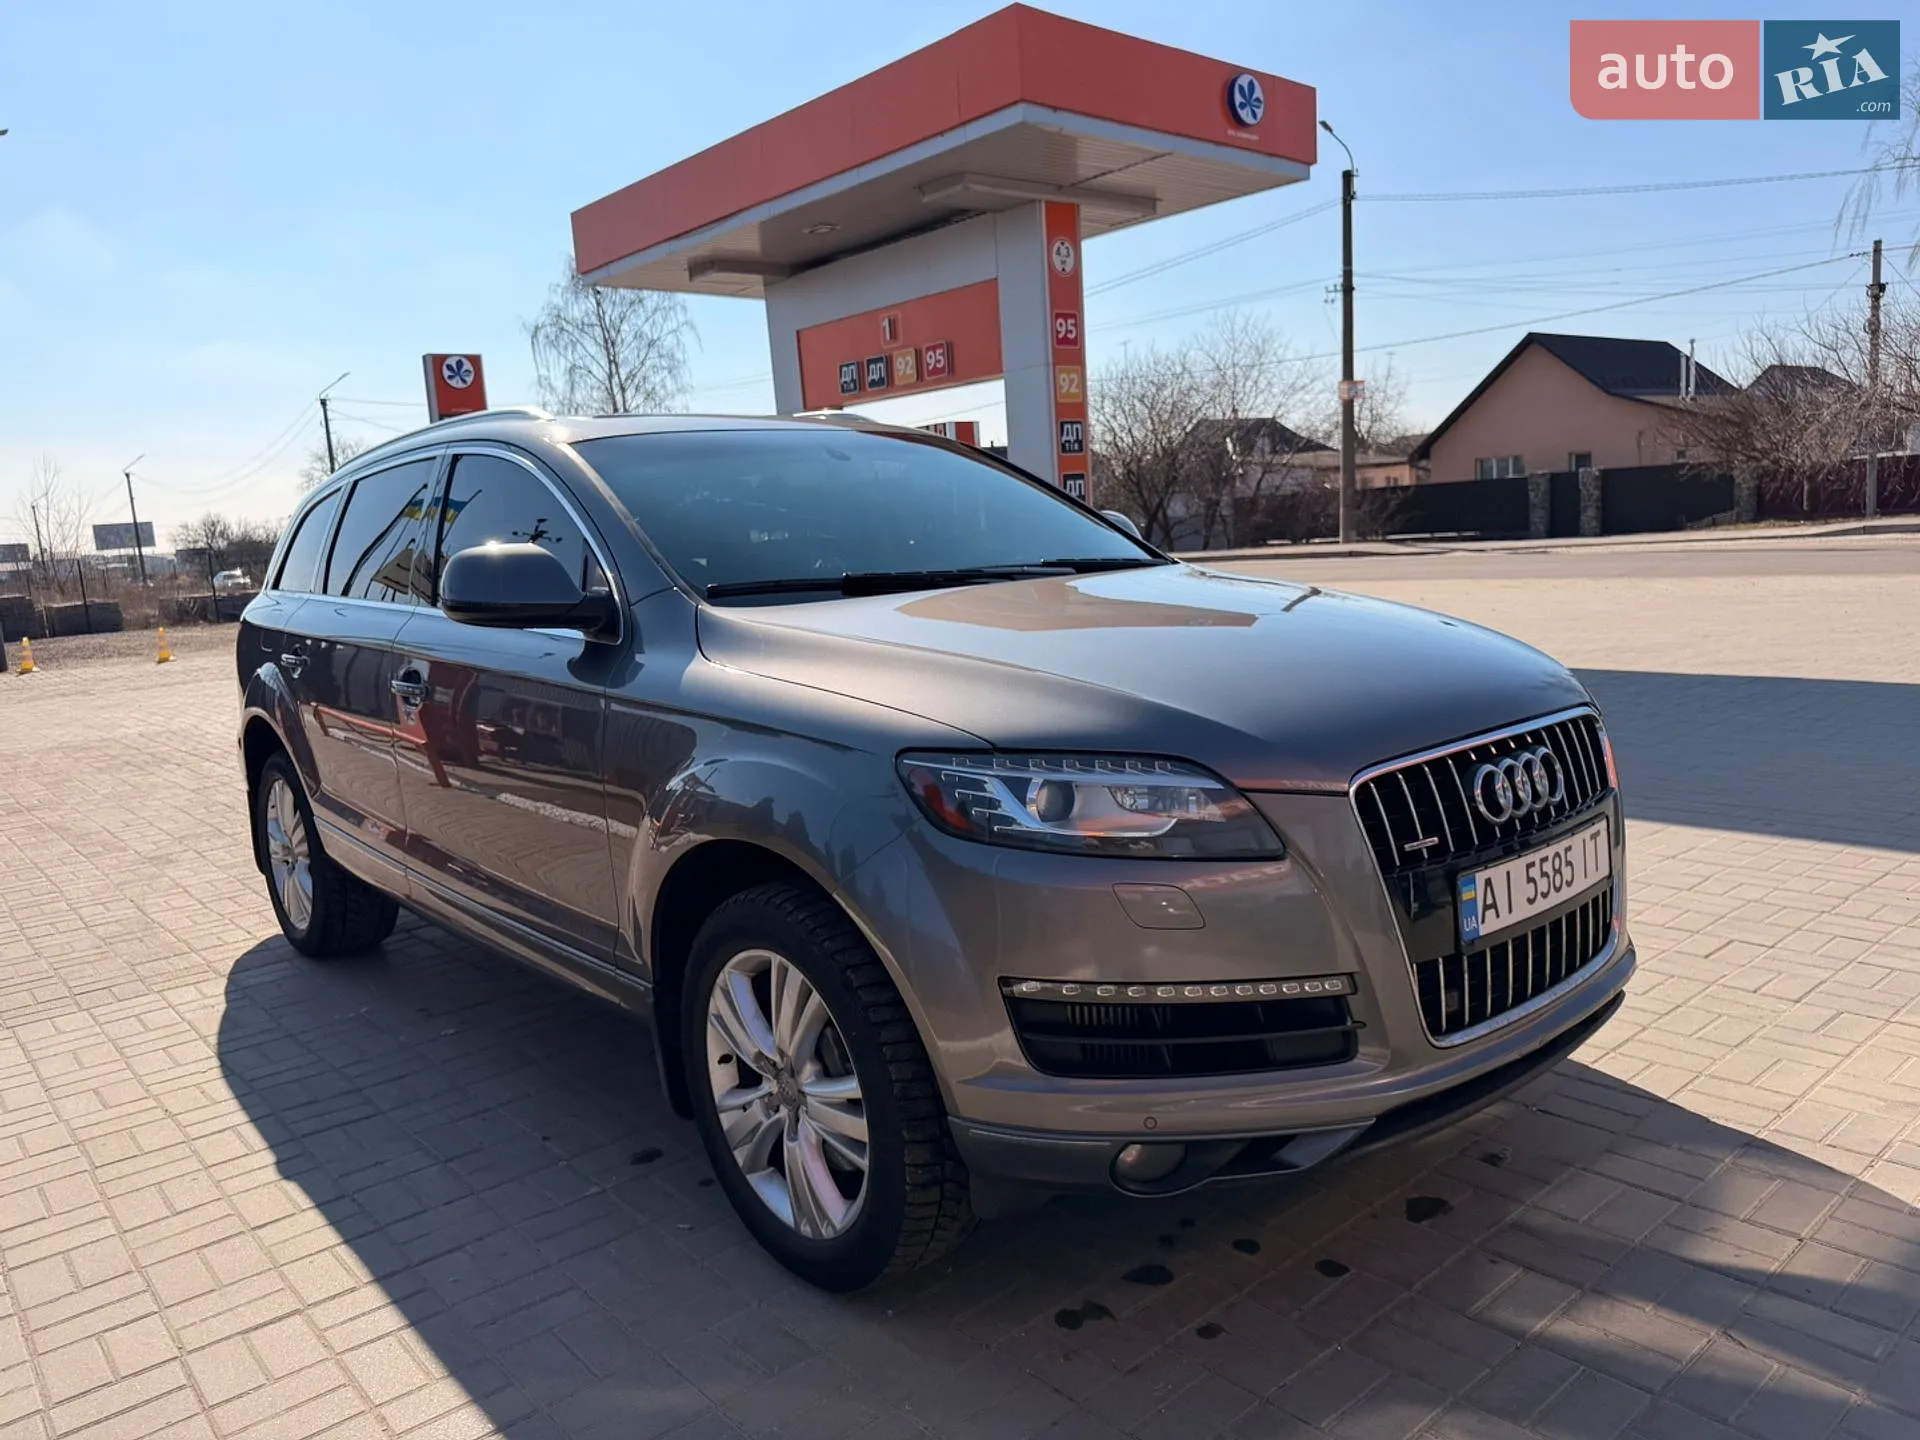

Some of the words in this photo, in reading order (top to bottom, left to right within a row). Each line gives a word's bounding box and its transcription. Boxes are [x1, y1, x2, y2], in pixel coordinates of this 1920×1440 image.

[1055, 318, 1077, 339] 95
[840, 365, 857, 383] ДП
[868, 362, 884, 382] ДП
[896, 356, 914, 376] 92
[926, 348, 945, 371] 95
[1059, 373, 1080, 394] 92
[1061, 423, 1082, 443] ДП
[1481, 870, 1514, 926] AI
[1525, 844, 1576, 906] 5585
[1582, 829, 1602, 880] IT
[1463, 916, 1479, 932] UA
